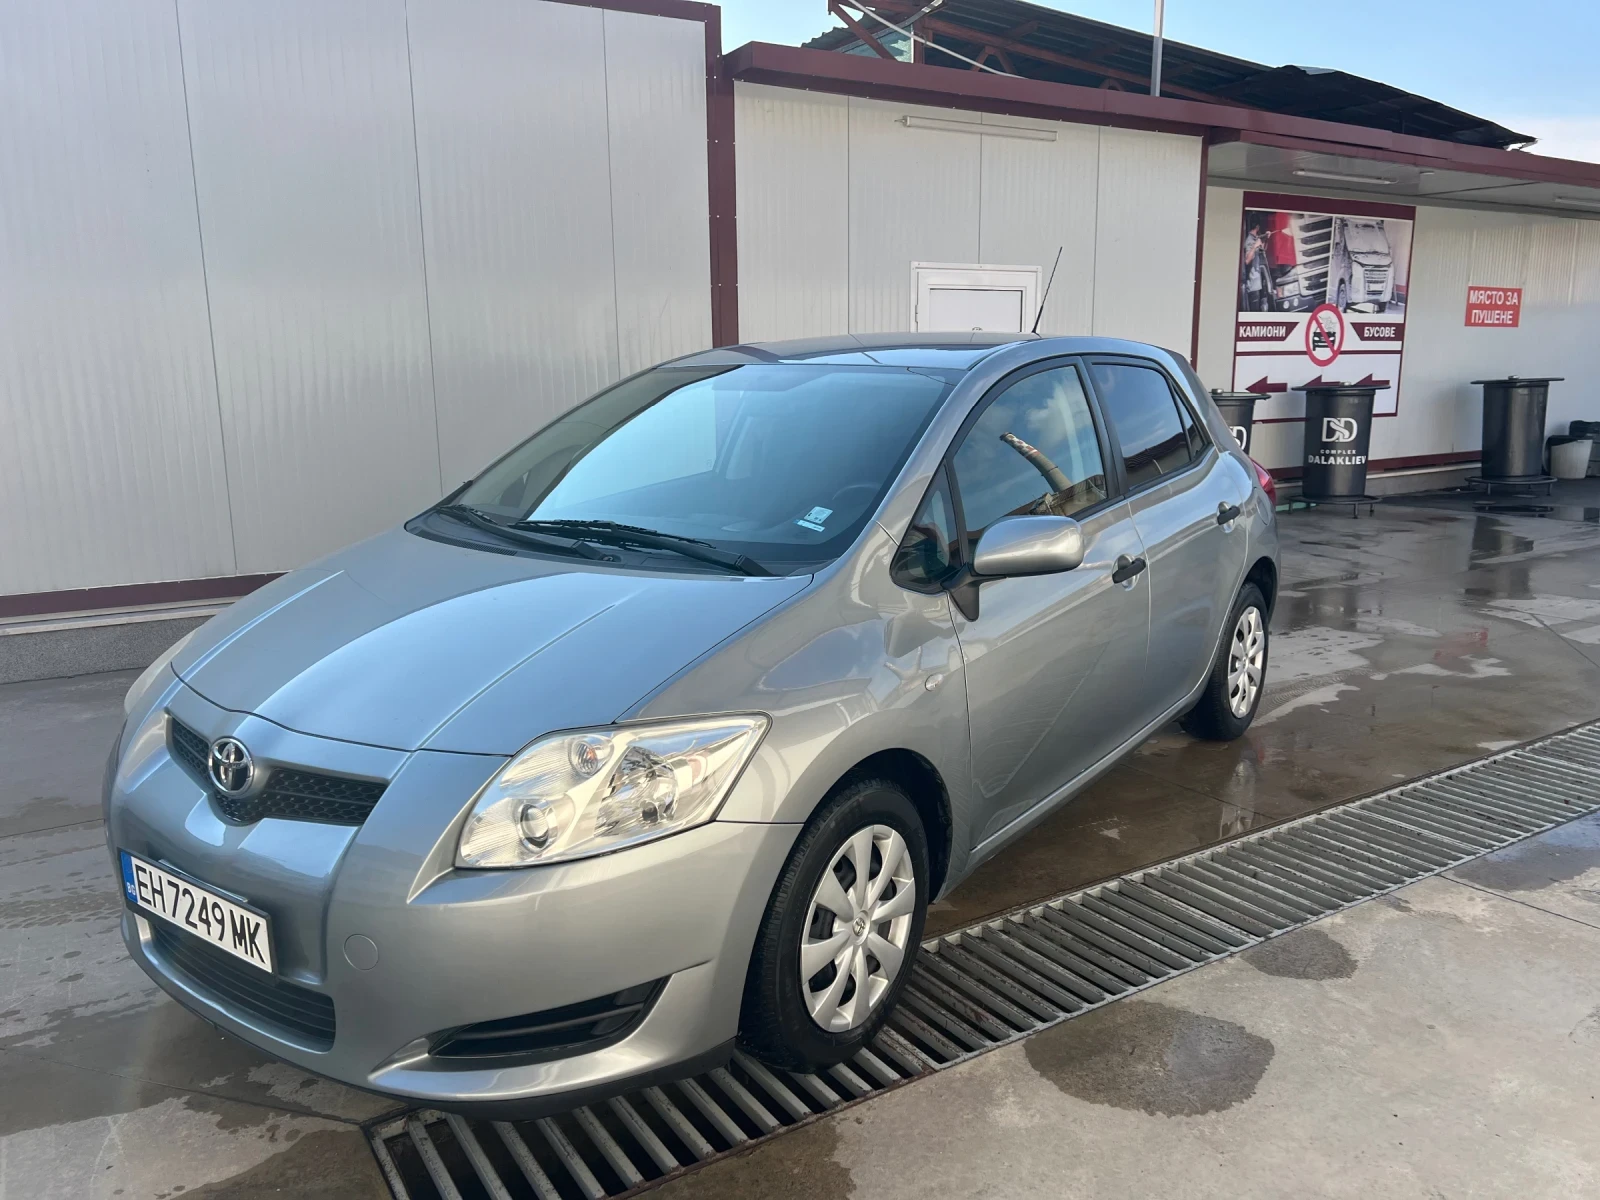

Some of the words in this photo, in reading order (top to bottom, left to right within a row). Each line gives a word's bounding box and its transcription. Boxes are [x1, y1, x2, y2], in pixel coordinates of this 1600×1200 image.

[1469, 290, 1504, 304] МЯСТО
[1506, 291, 1519, 305] ЗА
[1471, 309, 1514, 324] ПУШЕНЕ
[1239, 325, 1286, 338] КАМИОНИ
[1363, 326, 1396, 338] БУСОВЕ
[1308, 454, 1367, 465] DALAKLIEV
[126, 881, 136, 896] BG
